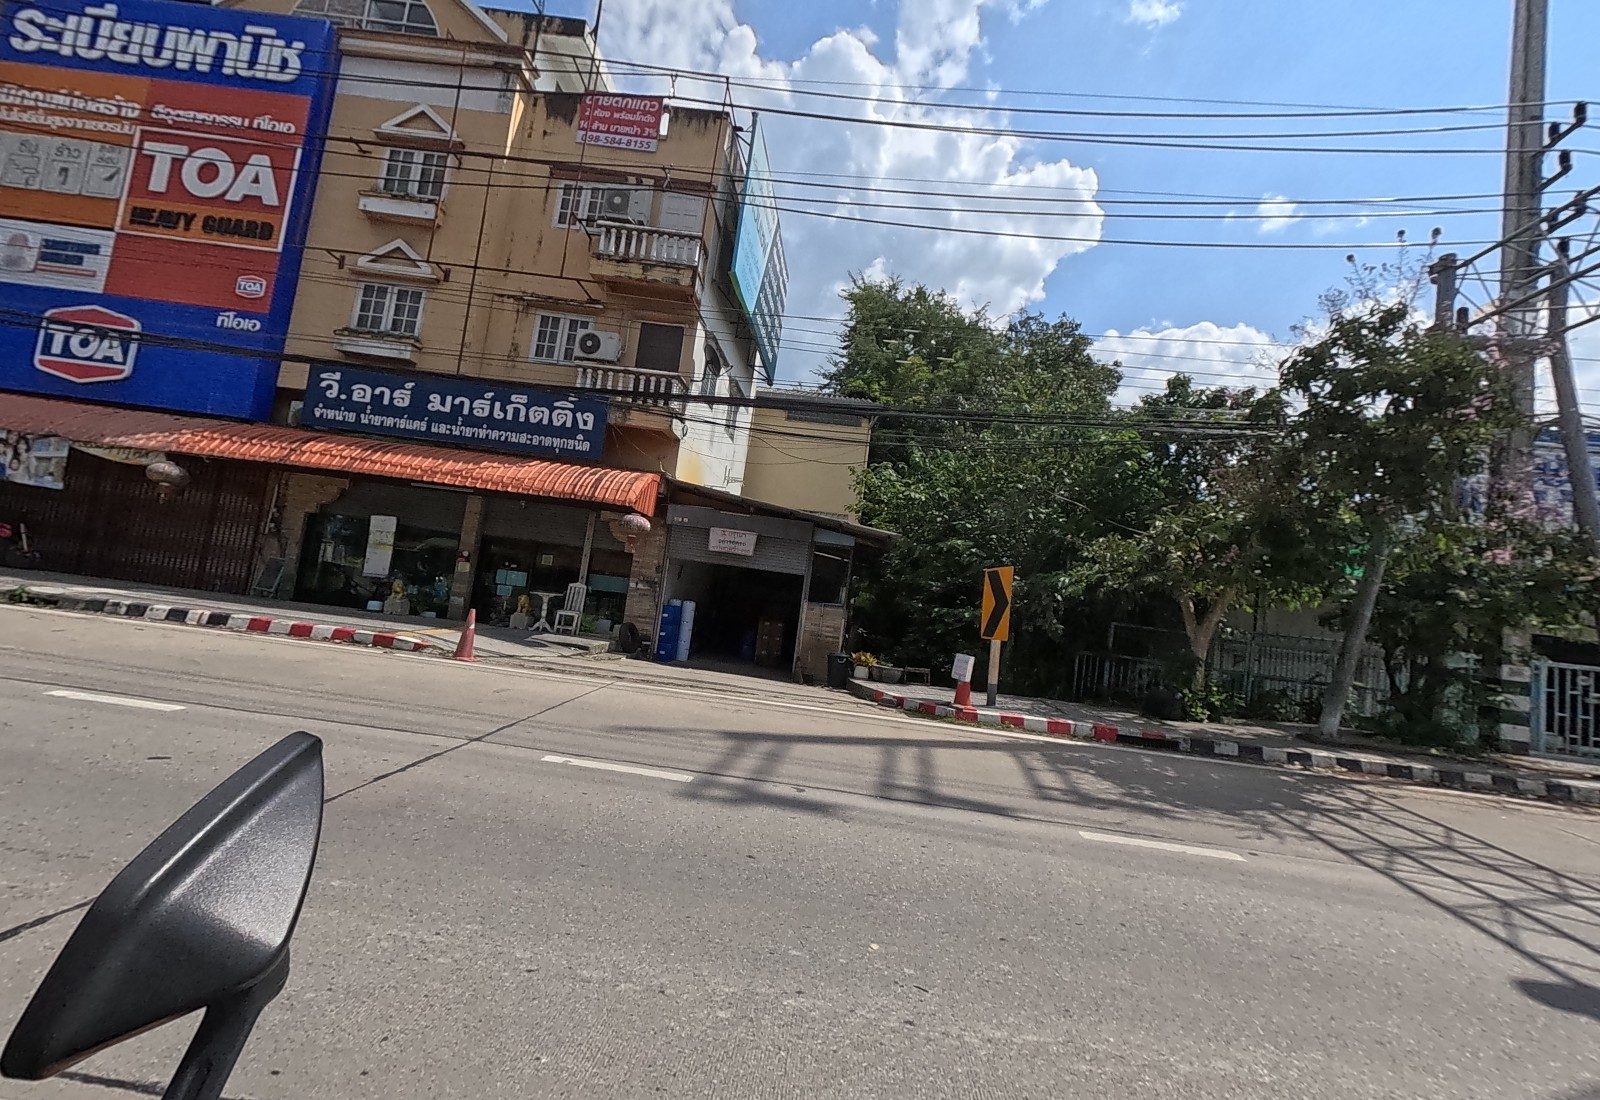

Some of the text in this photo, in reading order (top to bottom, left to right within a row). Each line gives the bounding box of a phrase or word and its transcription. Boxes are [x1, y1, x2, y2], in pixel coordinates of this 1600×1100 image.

[582, 135, 651, 149] 098-584-8155
[142, 141, 279, 206] TOA
[239, 281, 262, 293] TOA
[216, 312, 261, 332] ทีโอเอ
[48, 325, 125, 363] TOA
[320, 372, 595, 431] วี.อาร์ มาร์เก็ตติ้ง
[314, 403, 356, 423] จำหน่าย
[361, 405, 428, 431] น้ำยาคาร์แคร์
